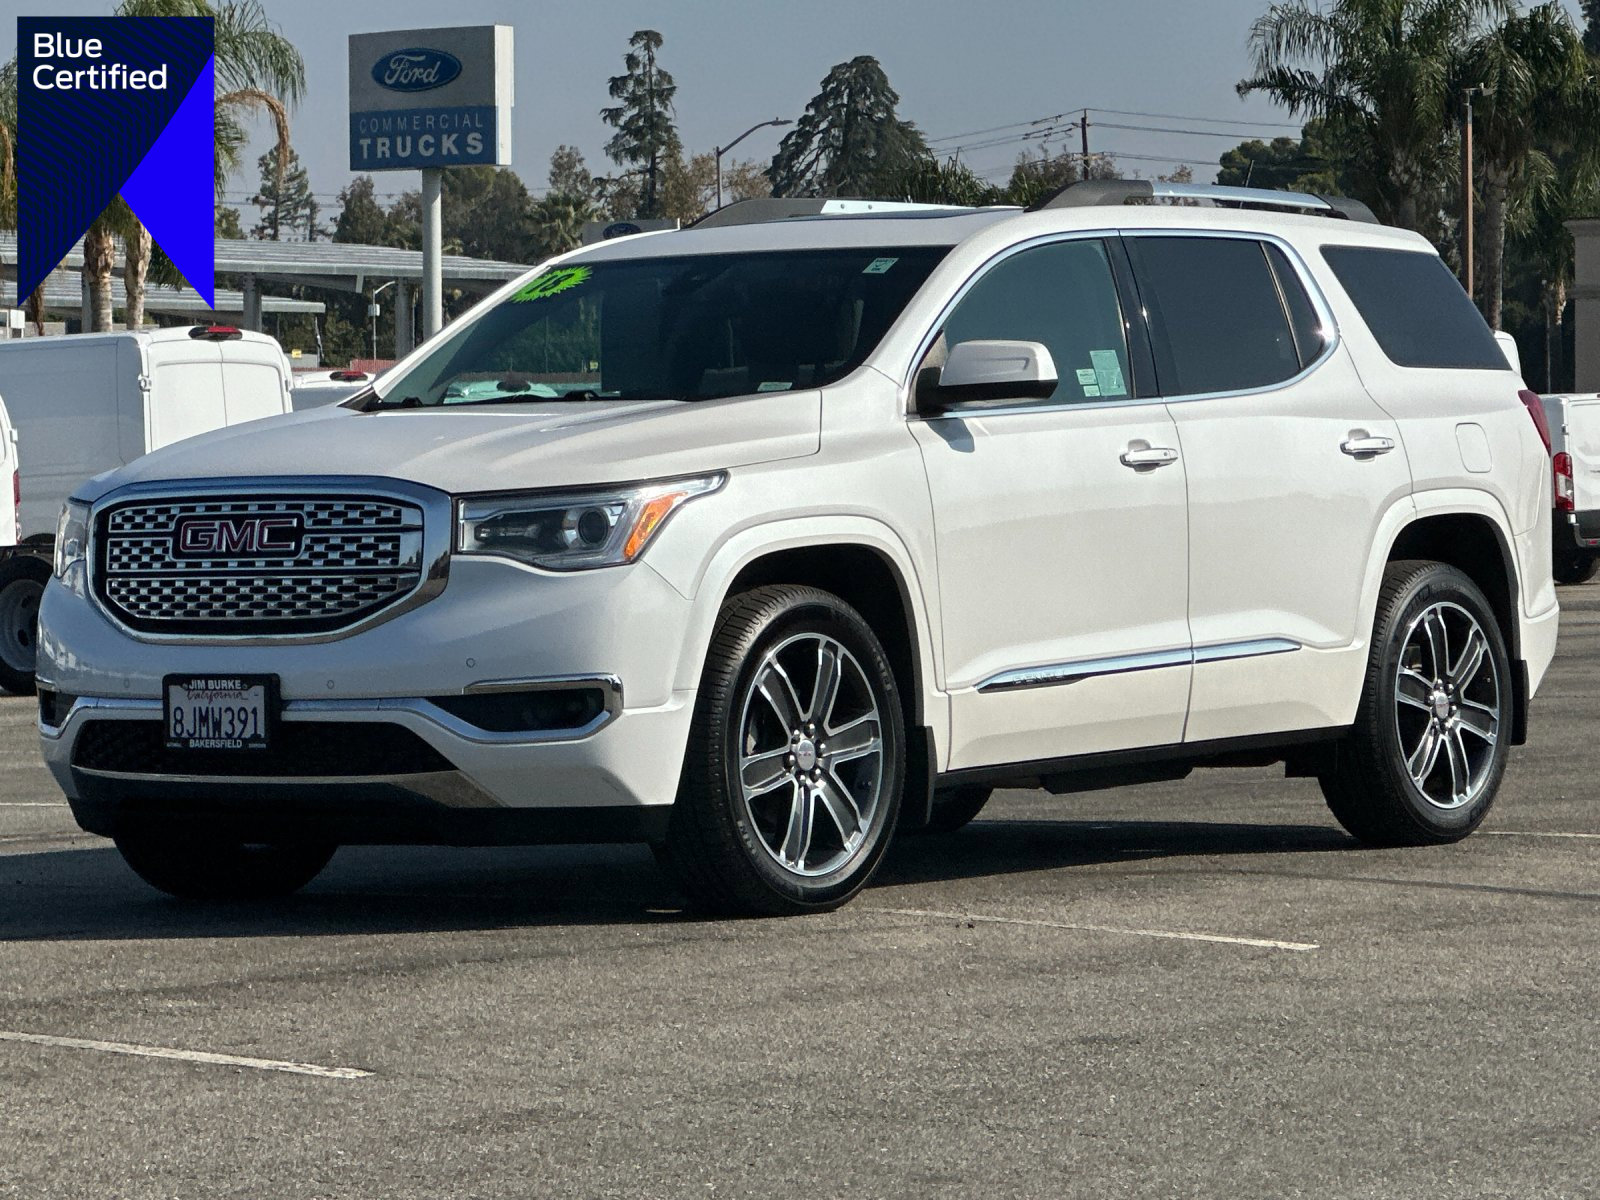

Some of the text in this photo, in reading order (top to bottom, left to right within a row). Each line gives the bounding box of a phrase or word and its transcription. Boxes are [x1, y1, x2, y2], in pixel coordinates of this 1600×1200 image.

[384, 54, 441, 85] Ford
[360, 112, 483, 134] COMMERCIAL
[359, 132, 484, 159] TRUCKS
[180, 518, 298, 552] GMC
[188, 679, 242, 690] JIM BURKE
[173, 706, 259, 738] 8JMW391
[189, 739, 243, 748] BAKERSFIELD
